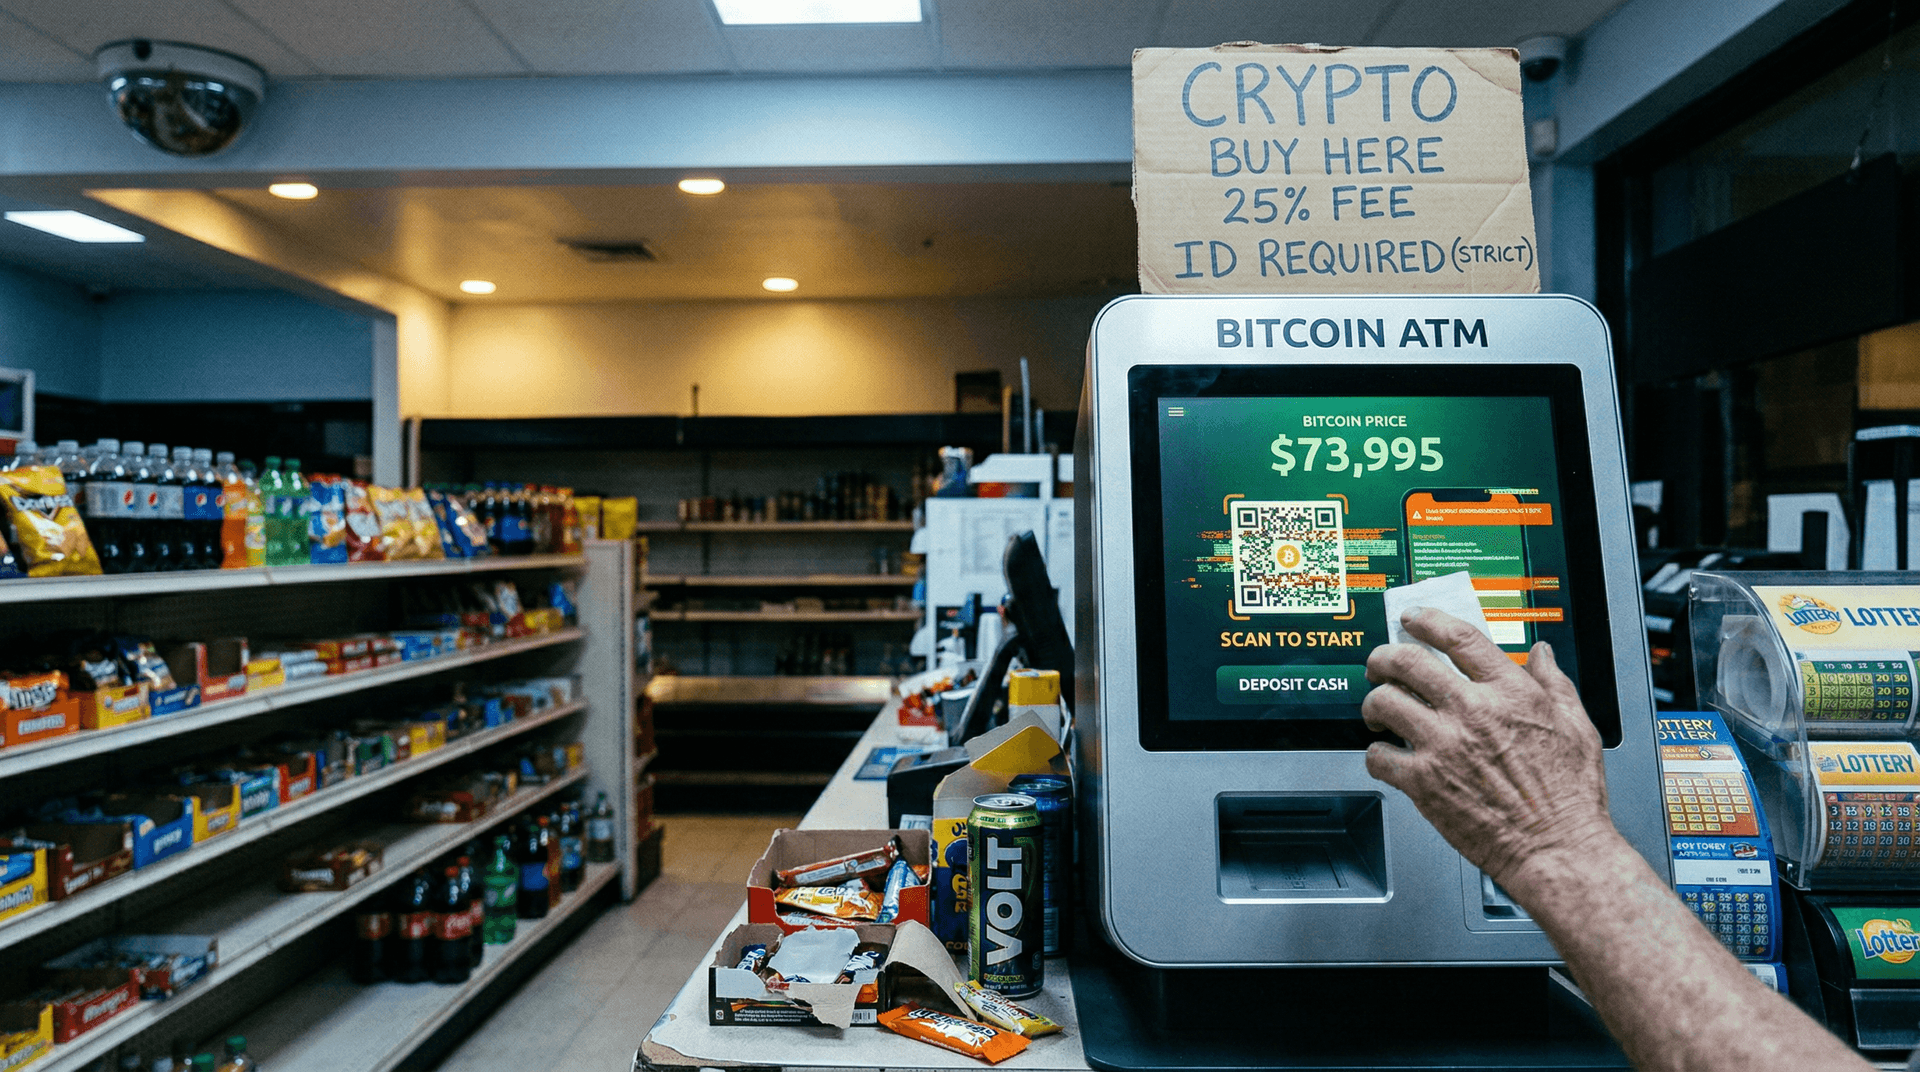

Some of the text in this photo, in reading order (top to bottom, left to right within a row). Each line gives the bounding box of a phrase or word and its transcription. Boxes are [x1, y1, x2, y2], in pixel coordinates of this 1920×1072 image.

[1181, 62, 1458, 127] CRYPTO
[1210, 136, 1445, 177] BUY HERE
[1223, 185, 1416, 225] 25% FEE
[1174, 236, 1534, 279] ID REQUIRED (STRICT)
[1216, 318, 1489, 348] BITCOIN ATM
[1302, 415, 1407, 428] BITCOIN PRICE
[1270, 433, 1444, 478] $73,995
[1784, 608, 1842, 627] LOTTERY
[1220, 631, 1364, 648] SCAN TO START
[1239, 677, 1348, 692] DEPOSIT CASH
[1836, 754, 1915, 773] LOTTERY
[1830, 821, 1842, 831] 12
[1846, 821, 1859, 831] 12
[986, 837, 1023, 966] VOLT
